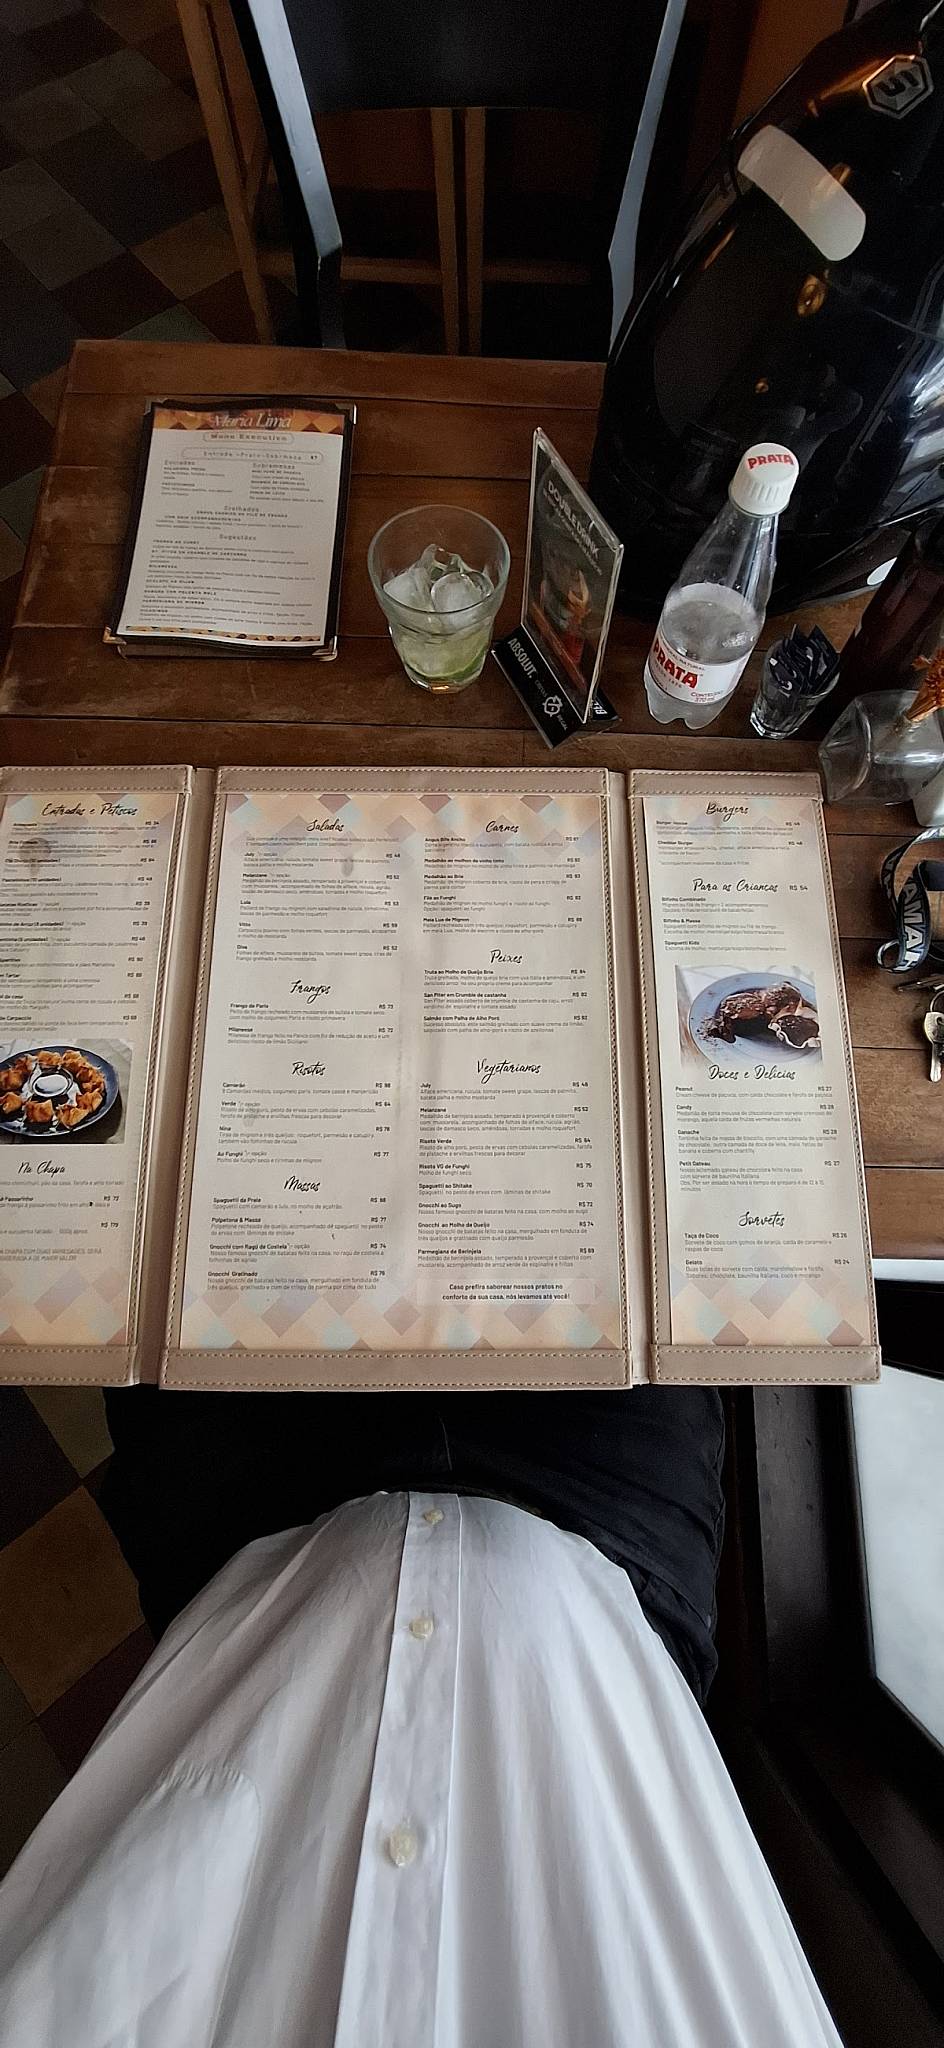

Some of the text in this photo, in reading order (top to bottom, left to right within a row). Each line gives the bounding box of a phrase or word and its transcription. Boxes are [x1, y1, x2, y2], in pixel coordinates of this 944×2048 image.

[256, 413, 292, 428] Lima
[747, 453, 794, 470] PRATA
[653, 638, 699, 689] PRATA
[42, 803, 86, 816] Entradas
[100, 802, 138, 816] Petiscos
[705, 801, 749, 822] Burgers
[306, 818, 344, 832] Saladas
[485, 820, 519, 833] Carnes
[693, 878, 717, 891] Para
[895, 877, 924, 971] AMAH
[490, 949, 522, 964] Peixes
[290, 980, 331, 1004] Frangos
[292, 1061, 326, 1076] Risotos
[477, 1058, 541, 1084] Vegetarianos
[709, 1064, 739, 1080] Doces
[18, 1160, 65, 1178] Na Chapa
[284, 1175, 321, 1192] Massas
[739, 1211, 785, 1227] Sorvetes
